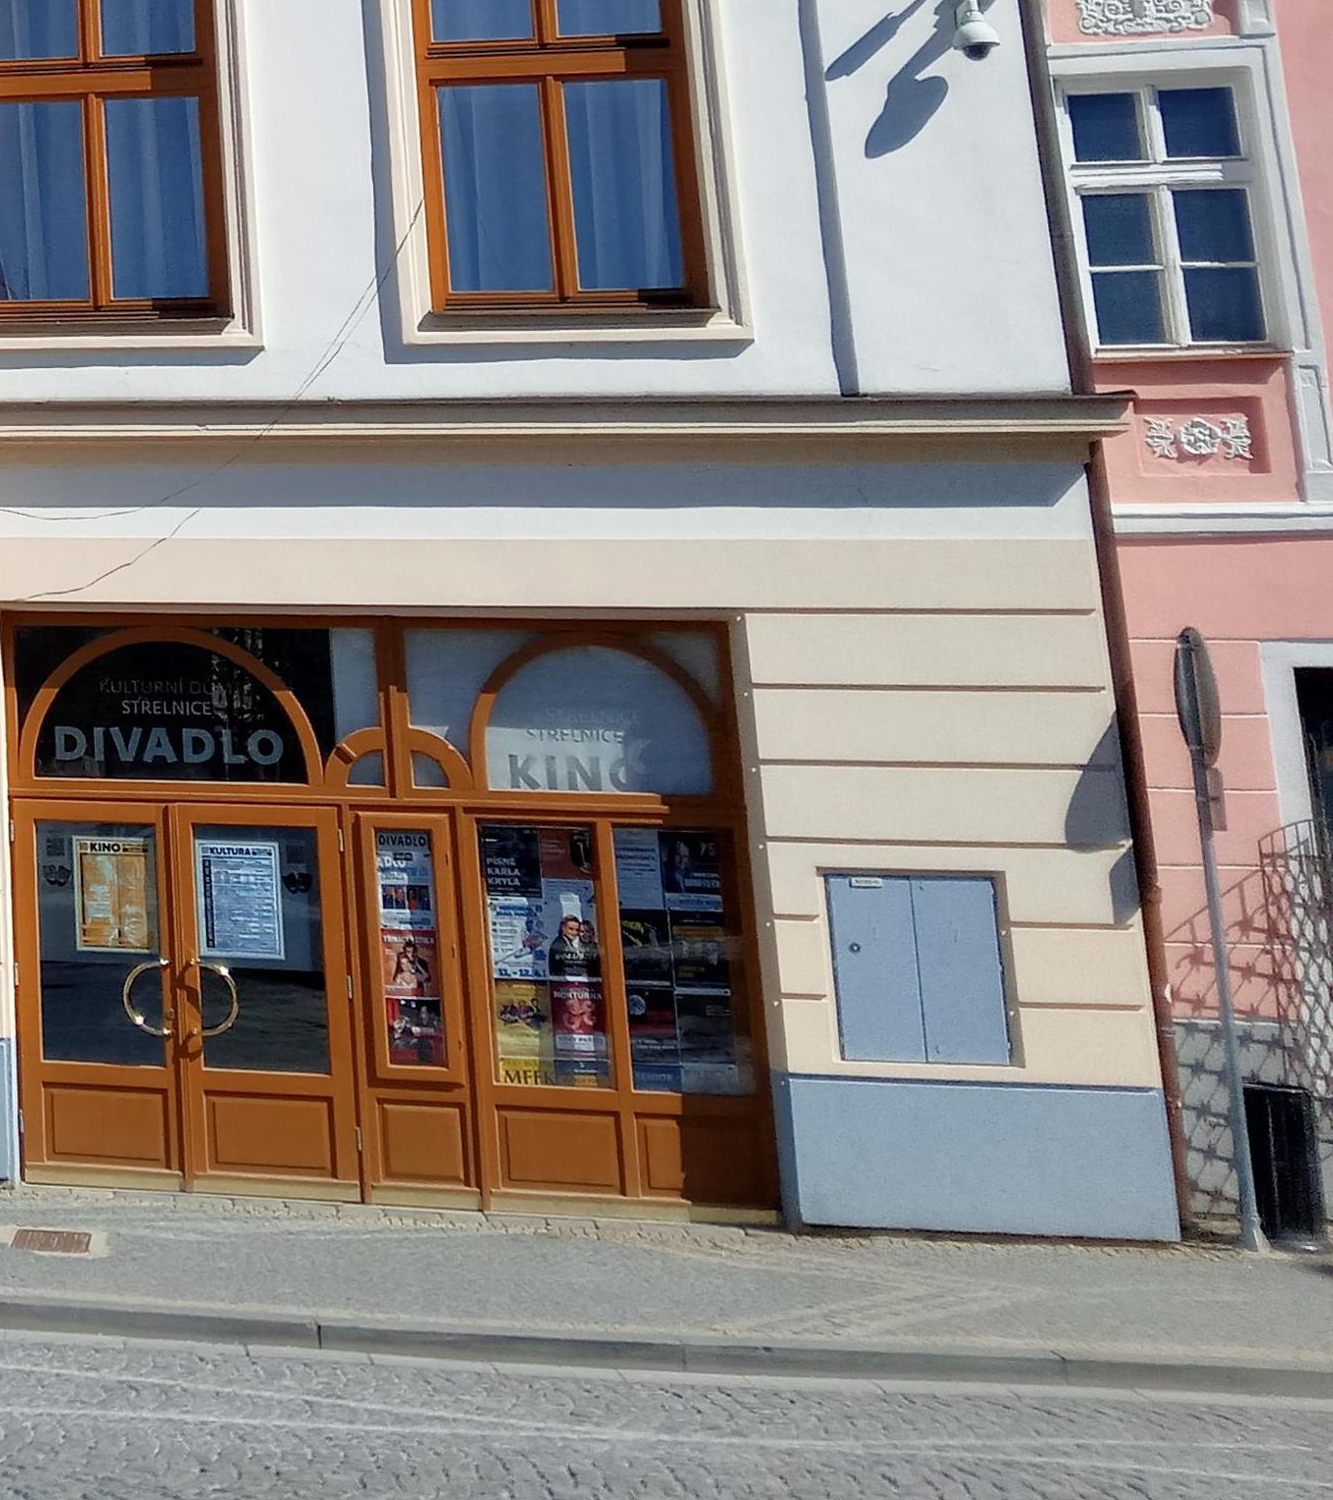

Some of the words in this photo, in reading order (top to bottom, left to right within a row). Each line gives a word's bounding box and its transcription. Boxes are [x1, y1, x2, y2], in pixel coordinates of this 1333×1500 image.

[99, 677, 185, 695] KULTURNÍ
[54, 726, 284, 765] DIVADLO
[378, 834, 427, 847] DIVADLO
[89, 842, 121, 853] KINO
[209, 847, 252, 857] KULTURA
[487, 867, 521, 877] KARLA
[488, 877, 521, 887] KRYLA
[553, 990, 603, 1000] NOKTURNA
